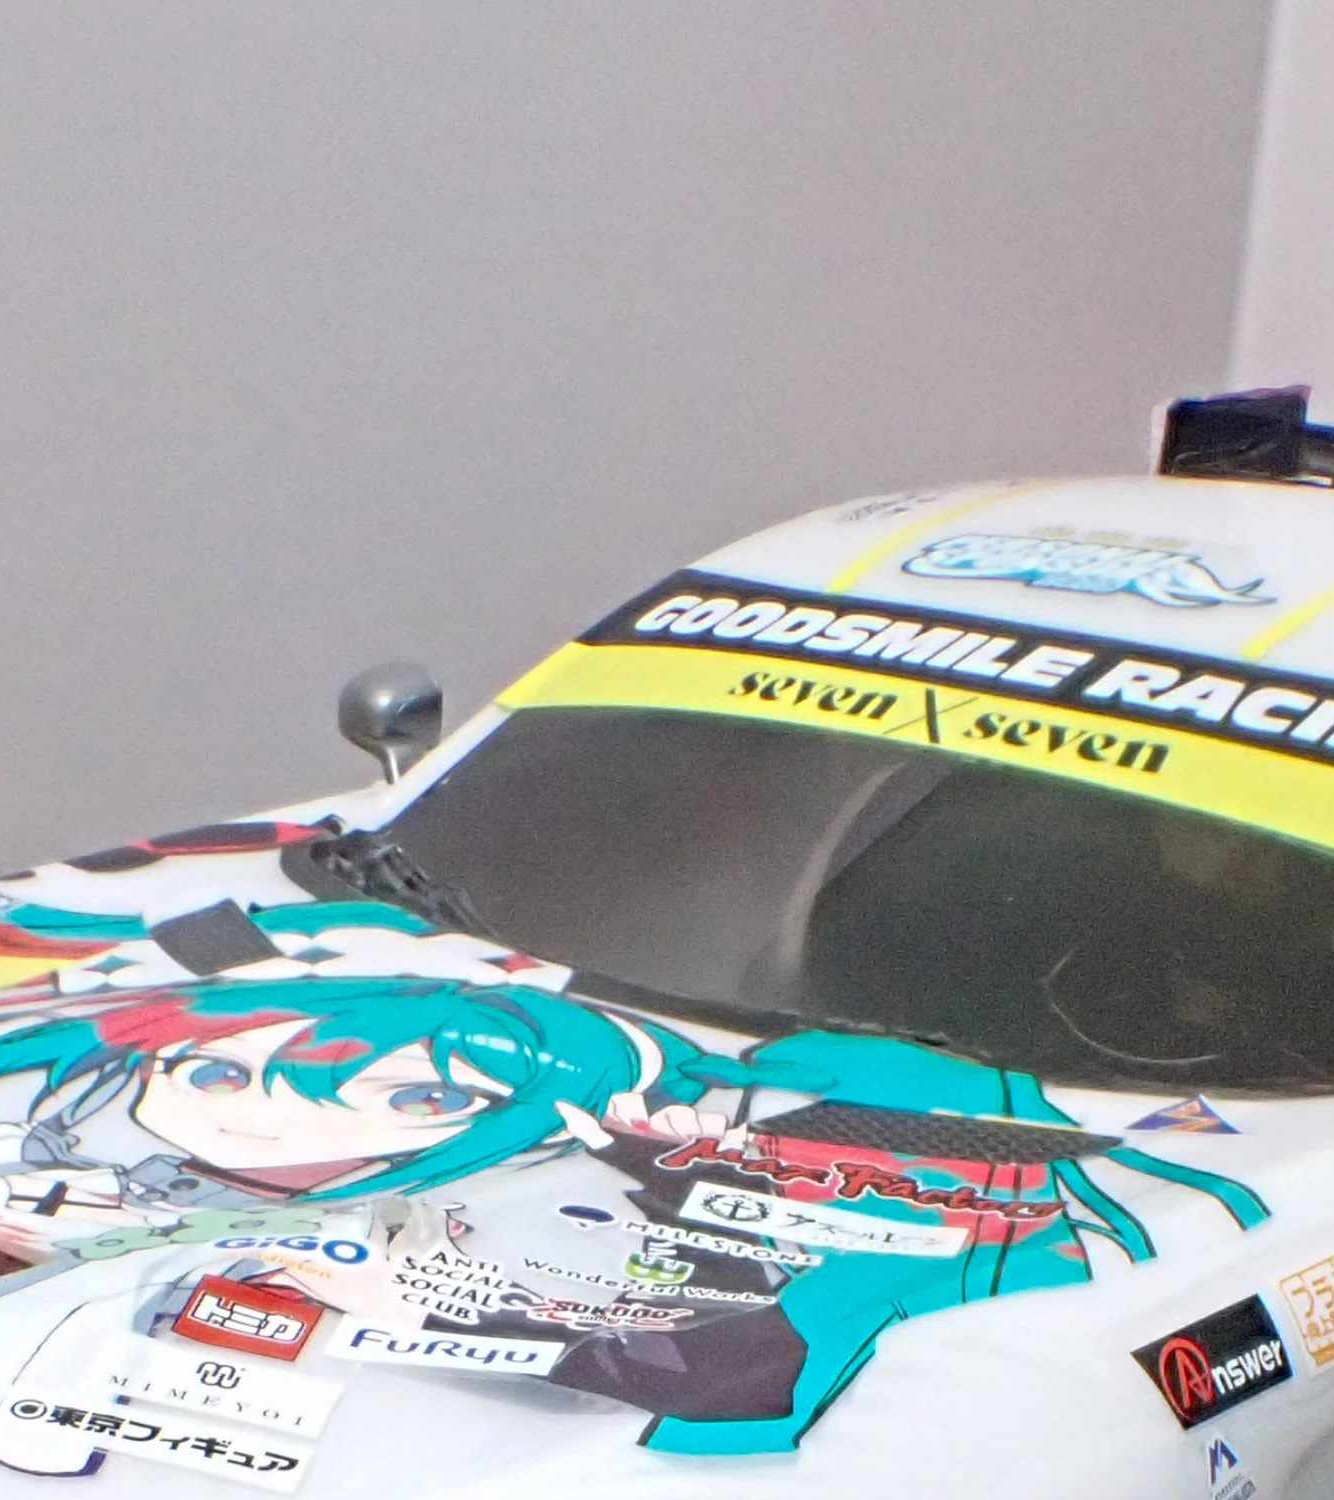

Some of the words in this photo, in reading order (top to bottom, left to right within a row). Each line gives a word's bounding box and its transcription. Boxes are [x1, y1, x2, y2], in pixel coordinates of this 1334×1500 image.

[634, 594, 1097, 690] GOODSMILE
[726, 664, 897, 724] seven
[963, 703, 1170, 776] seven
[214, 1236, 370, 1265] GiGO
[433, 1250, 501, 1274] ANTI
[625, 1219, 822, 1265] MILESTONE
[390, 1272, 496, 1310] SOCIAL
[402, 1256, 507, 1290] SOCIAL
[524, 1258, 679, 1297] Wonderful
[189, 1291, 307, 1344] トミカ
[402, 1292, 473, 1320] CLUB
[349, 1327, 540, 1367] FuRyu
[1158, 1335, 1283, 1421] Answer
[109, 1375, 305, 1426] MIMEYOI
[45, 1402, 300, 1474] 東京フィギュア
